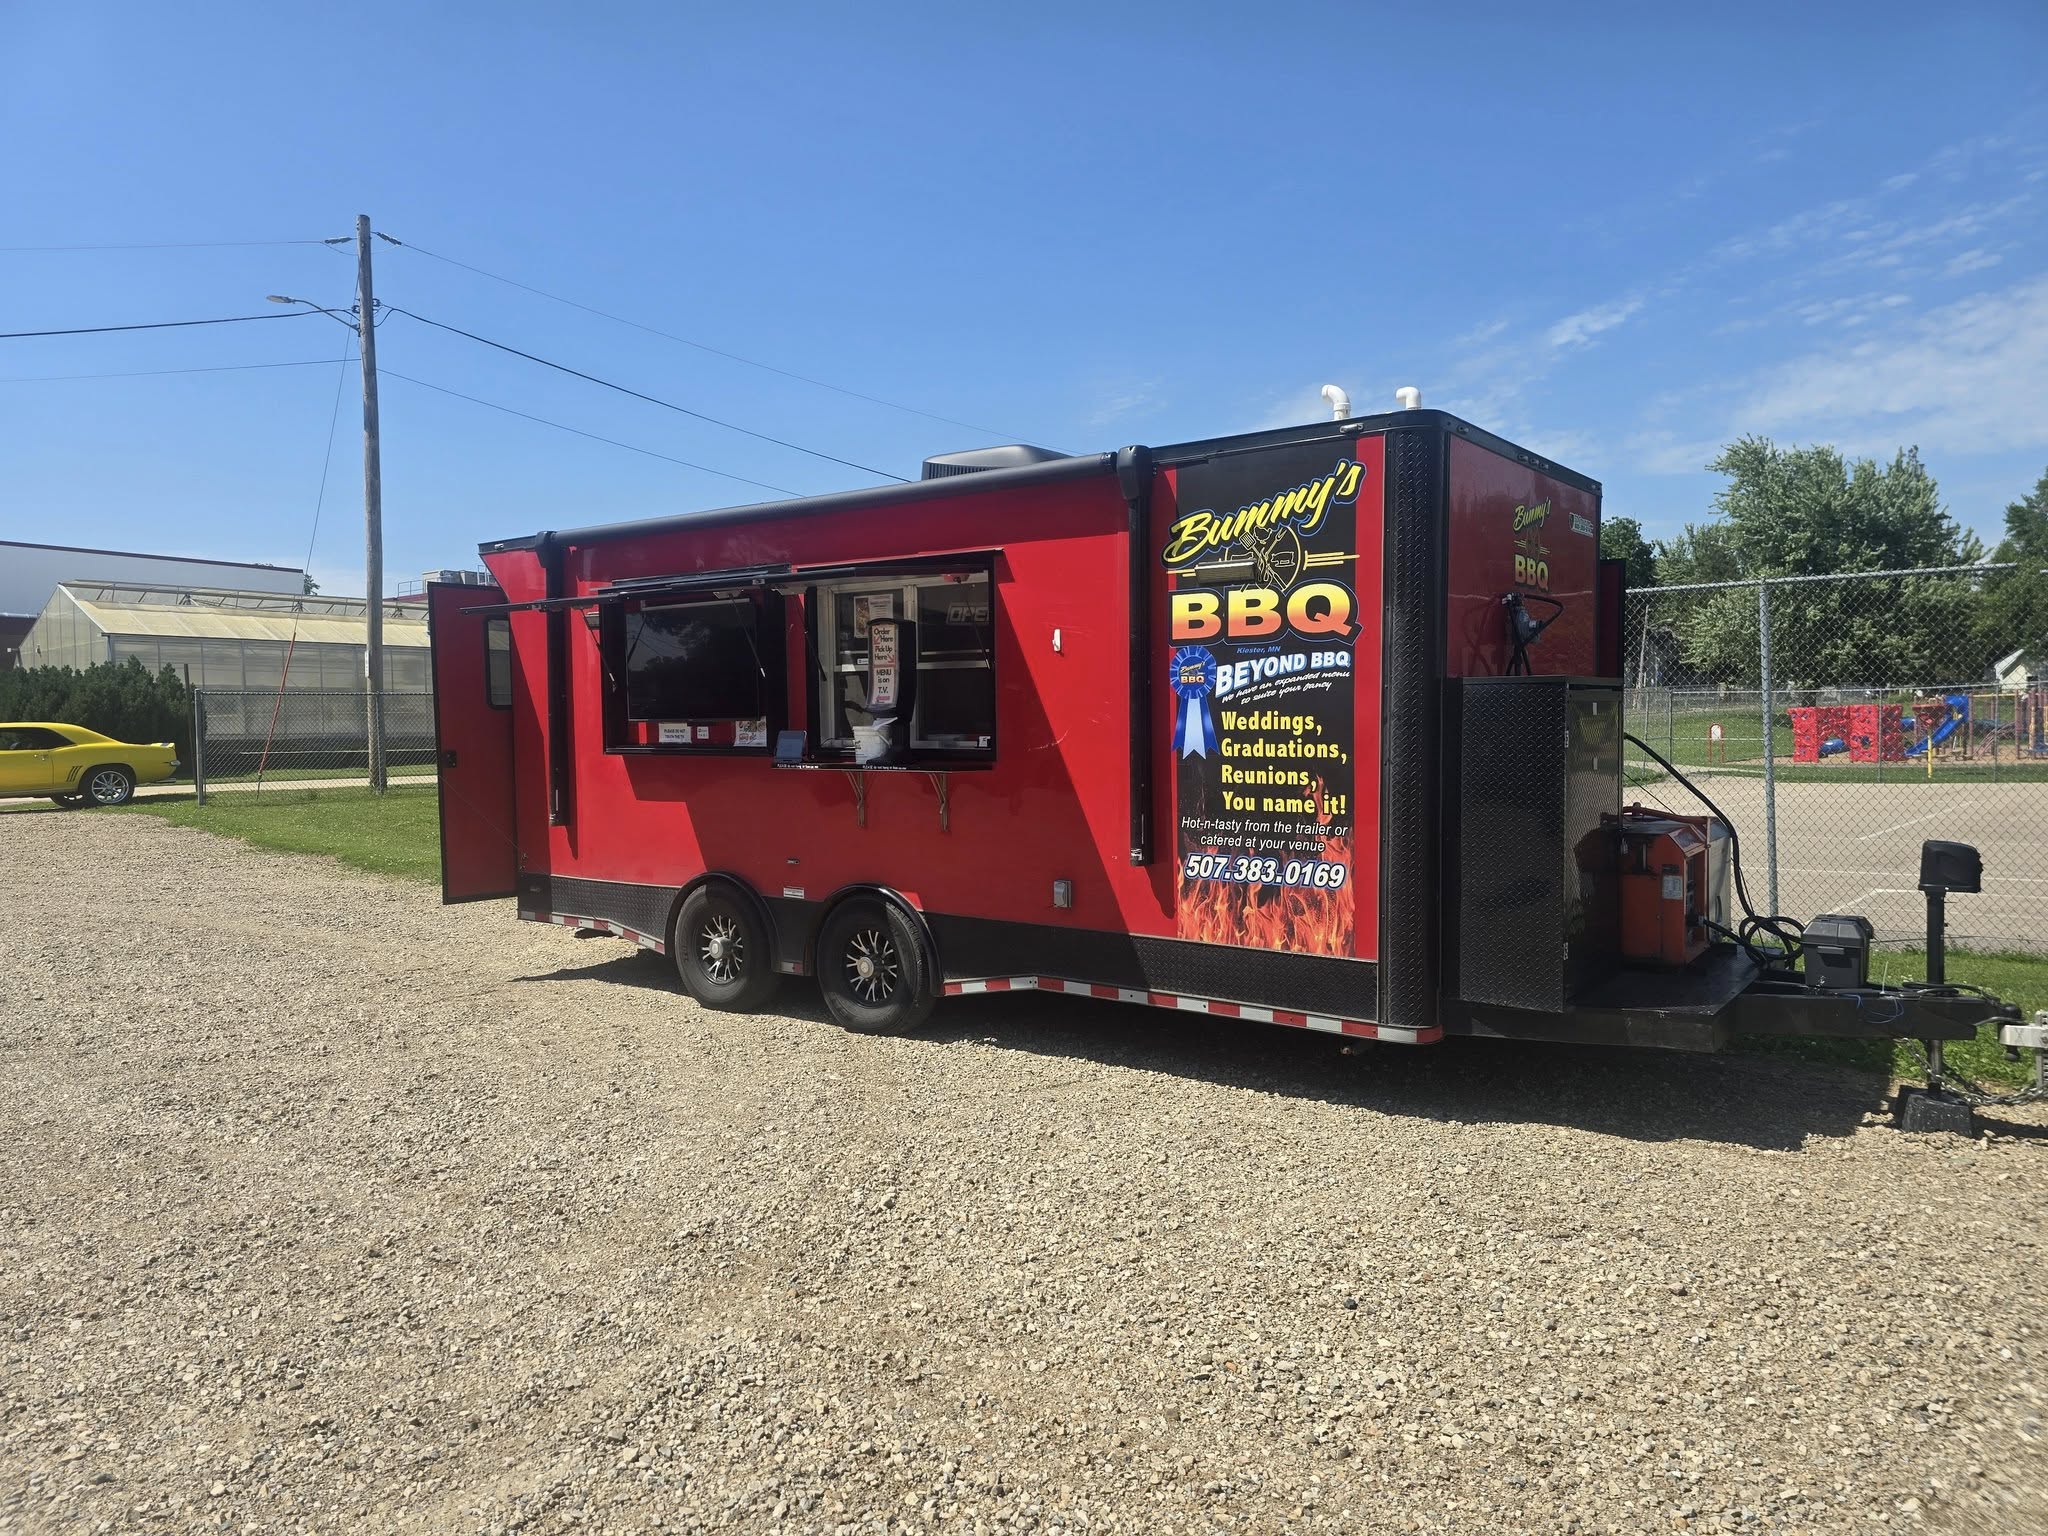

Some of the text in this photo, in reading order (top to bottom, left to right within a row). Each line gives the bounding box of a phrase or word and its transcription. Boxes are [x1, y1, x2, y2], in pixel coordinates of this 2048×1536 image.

[1162, 461, 1362, 563] Bummy's
[1513, 497, 1551, 531] Bummy's
[1515, 554, 1549, 591] BBQ
[950, 606, 990, 622] OPE
[1171, 583, 1352, 640] BBQ
[873, 628, 890, 636] Order
[1180, 675, 1205, 684] BBQ
[1215, 651, 1351, 698] BEYOND BBQ
[1236, 685, 1258, 698] have
[1259, 682, 1273, 690] an
[1274, 671, 1321, 688] expanded
[1241, 681, 1332, 705] to suite your fancy
[1221, 710, 1322, 736] Weddings,
[1221, 738, 1347, 764] Graduations,
[1221, 764, 1317, 791] Reunions,
[1222, 790, 1346, 815] You name it!
[1181, 816, 1348, 836] Hot-n-tasty from the trailer or
[1200, 834, 1326, 852] catered at your venue
[1185, 854, 1346, 888] 507.383.0169
